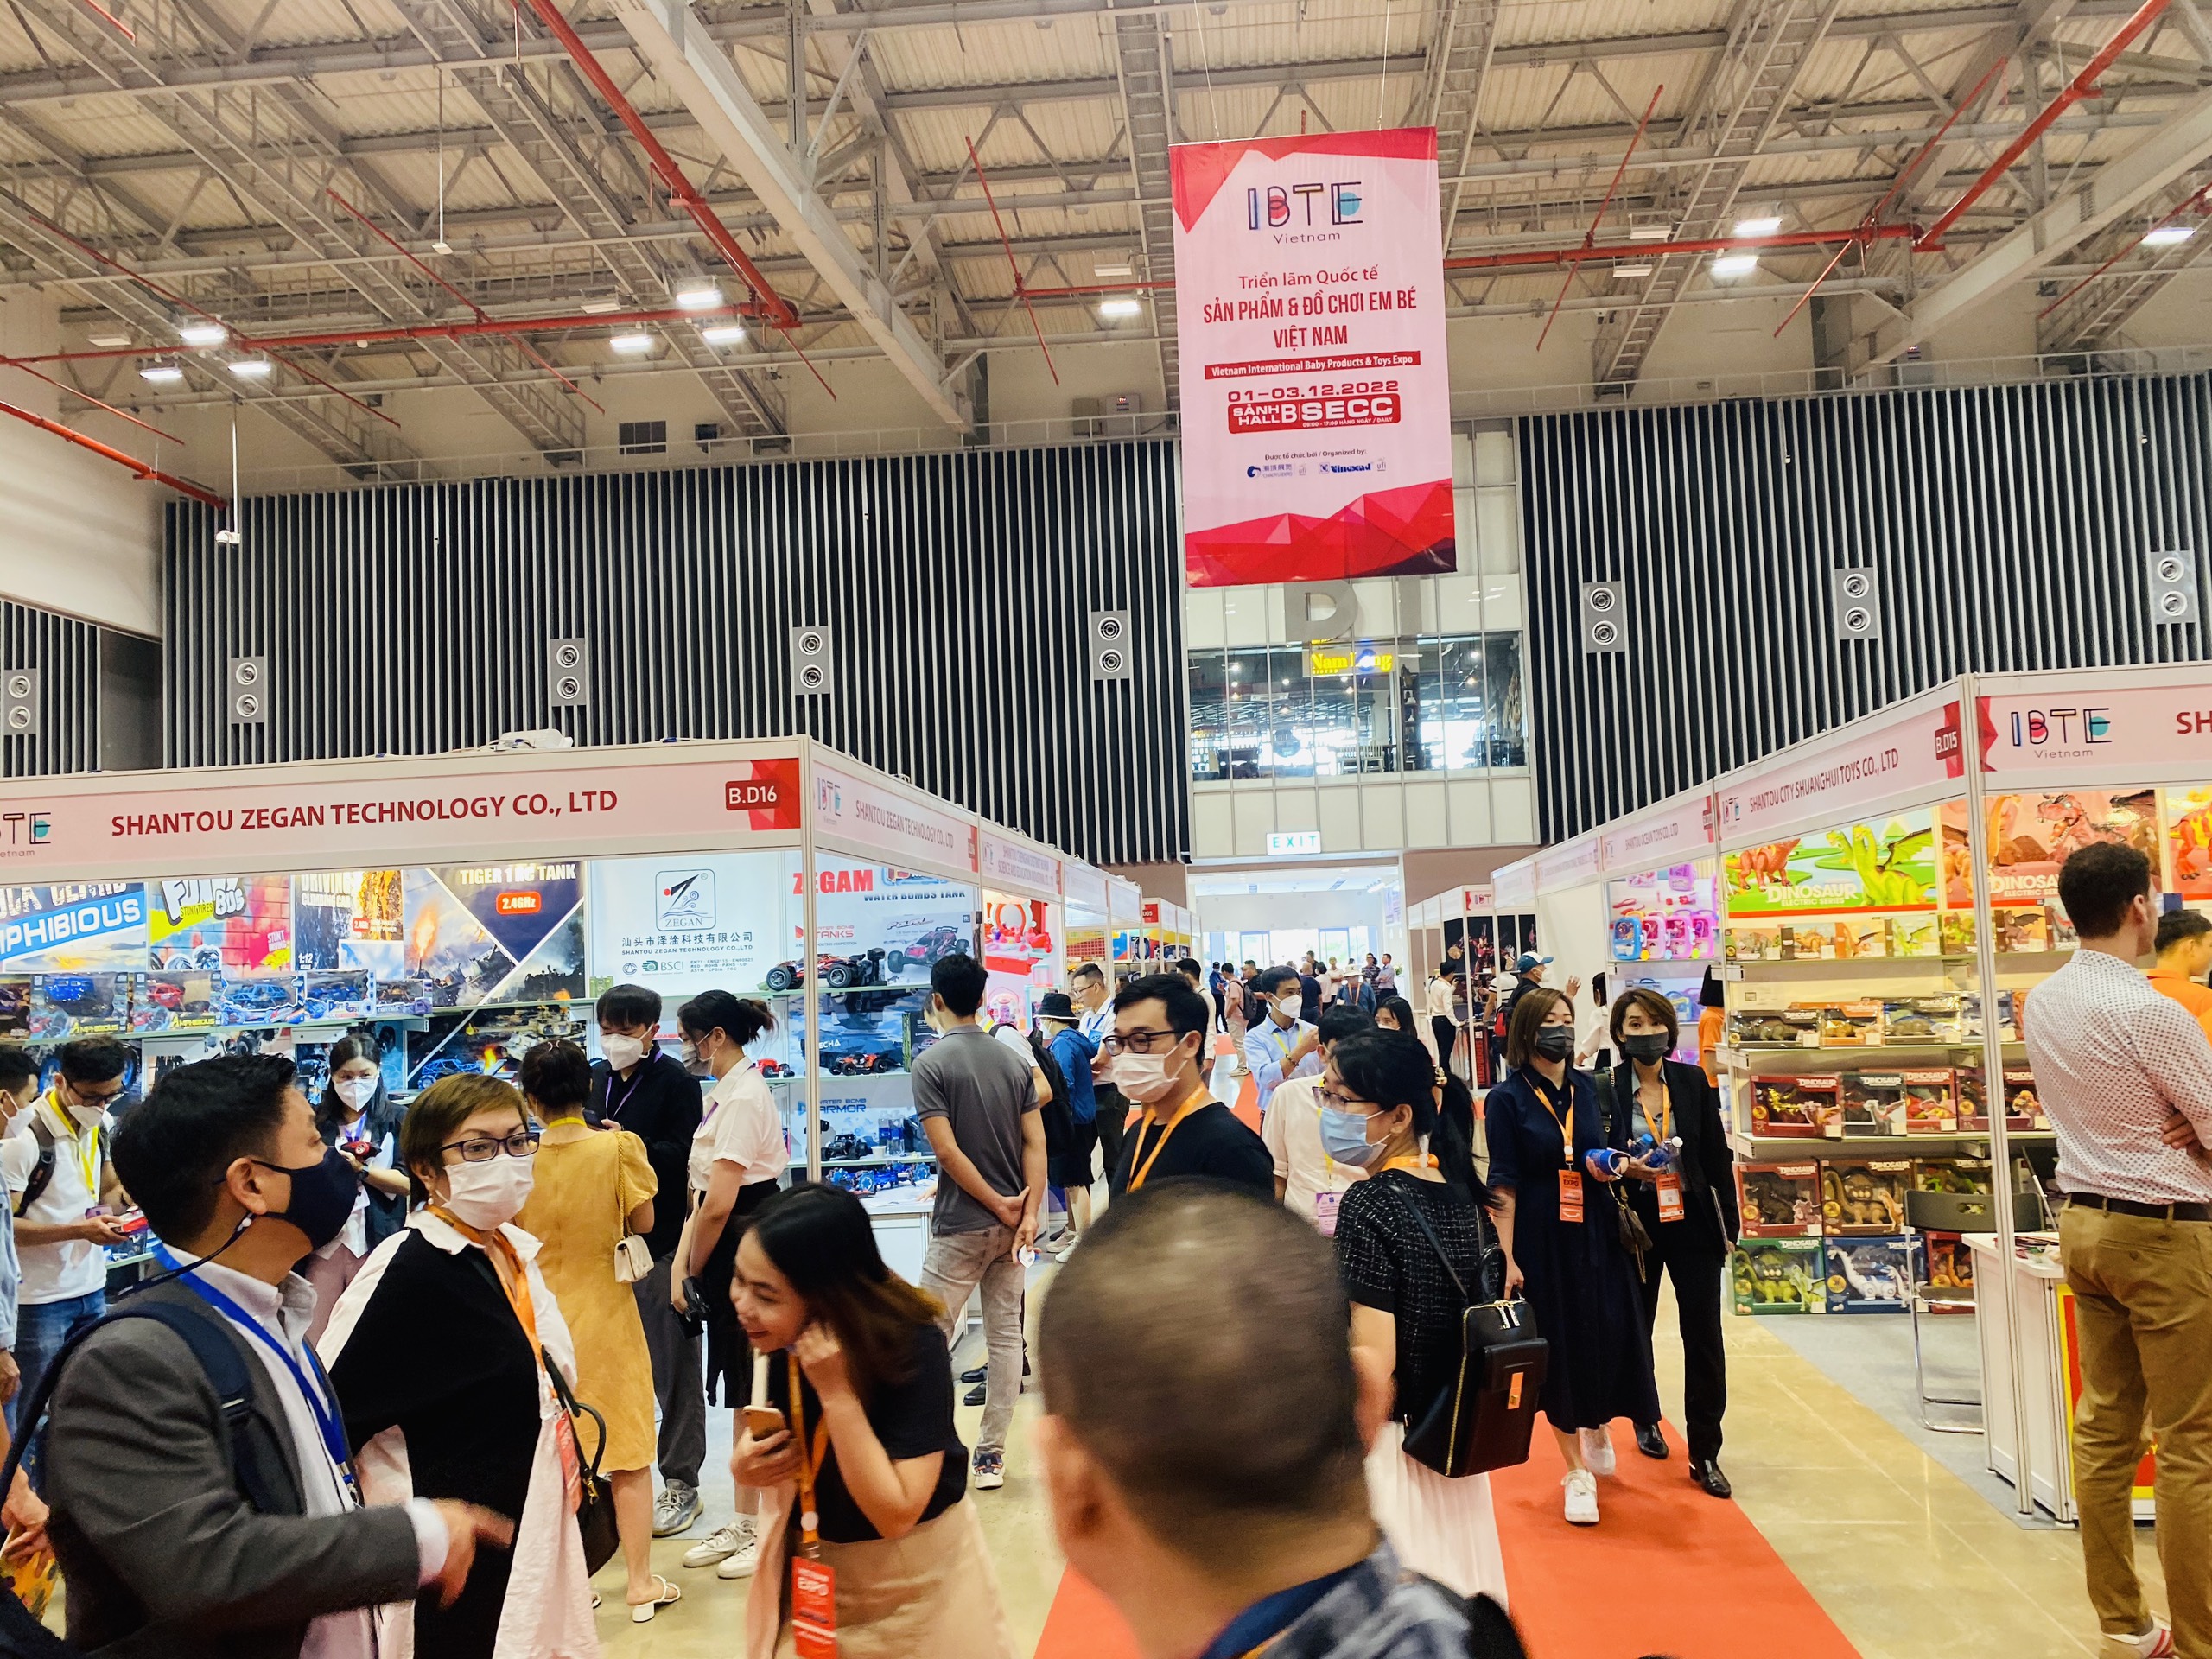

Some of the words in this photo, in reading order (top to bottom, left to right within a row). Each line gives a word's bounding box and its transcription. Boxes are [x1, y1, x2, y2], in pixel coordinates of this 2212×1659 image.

[1247, 181, 1363, 230] IBTE
[1273, 232, 1340, 245] Vietnam
[1238, 271, 1278, 289] Triển
[1283, 271, 1312, 286] lãm
[1316, 266, 1357, 285] Quốc
[1363, 264, 1379, 281] tế
[1204, 297, 1234, 323] SẢN
[1238, 291, 1283, 320] PHẨM
[1288, 300, 1299, 316] &
[1303, 290, 1324, 315] ĐỒ
[1328, 293, 1364, 314] CHƠI
[1370, 291, 1392, 311] EM
[1397, 286, 1417, 309] BÉ
[1273, 325, 1306, 352] VIỆT
[1313, 325, 1348, 346] NAM
[1211, 366, 1247, 377] Vietnam
[1249, 361, 1303, 374] International
[1305, 359, 1325, 372] Baby
[1327, 357, 1363, 369] Products
[1365, 357, 1372, 365] &
[1373, 355, 1391, 366] Toys
[1392, 354, 1414, 366] Expo
[1238, 415, 1281, 426] HALL
[1281, 404, 1298, 423] B
[1301, 397, 1394, 422] SECC
[1311, 653, 1348, 669] Nam
[1350, 652, 1393, 672] Lng
[2011, 708, 2113, 747] IBTE
[2176, 711, 2212, 734] SH
[1936, 732, 1958, 753] B.D15
[2034, 749, 2094, 759] Vietnam
[1750, 790, 1779, 813] SHANTOU
[1780, 783, 1795, 804] CITY
[1795, 771, 1840, 798] SHUANGHUI
[1839, 760, 1861, 785] TOYS
[1880, 747, 1898, 772] LTD
[728, 785, 778, 805] B.D16
[111, 810, 233, 836] SHANTOU
[240, 805, 324, 830] ZEGAN
[330, 795, 506, 825] TECHNOLOGY
[512, 793, 562, 817] CO.,
[569, 790, 618, 812] LTD
[0, 812, 51, 844] TE
[855, 799, 886, 827] SHANTOU
[887, 810, 905, 832] ZEGAN
[905, 817, 937, 843] TECHNOLOGY
[945, 830, 954, 849] LTD
[1273, 835, 1317, 848] EXIT
[0, 849, 35, 858] etnam
[460, 868, 502, 885] TIGER
[505, 867, 512, 883] 1
[537, 863, 576, 880] TANK
[1989, 873, 2060, 894] DINOSA
[215, 888, 245, 916] BUS
[502, 897, 537, 910] 2.4GHz
[1474, 894, 1492, 904] IBT
[1766, 883, 1859, 905] DINOSAUR
[1819, 896, 1845, 905] SERIES
[0, 898, 141, 954] PHIBIOUS
[665, 917, 703, 928] ZEGAN
[267, 930, 285, 944] STUNT
[298, 952, 314, 964] 1:12
[660, 961, 684, 971] BSCI
[819, 1039, 841, 1050] ECHA
[1796, 1078, 1837, 1087] DINOSAUR
[1860, 1077, 1902, 1085] DINOSAUR
[819, 1104, 867, 1114] ARMOR
